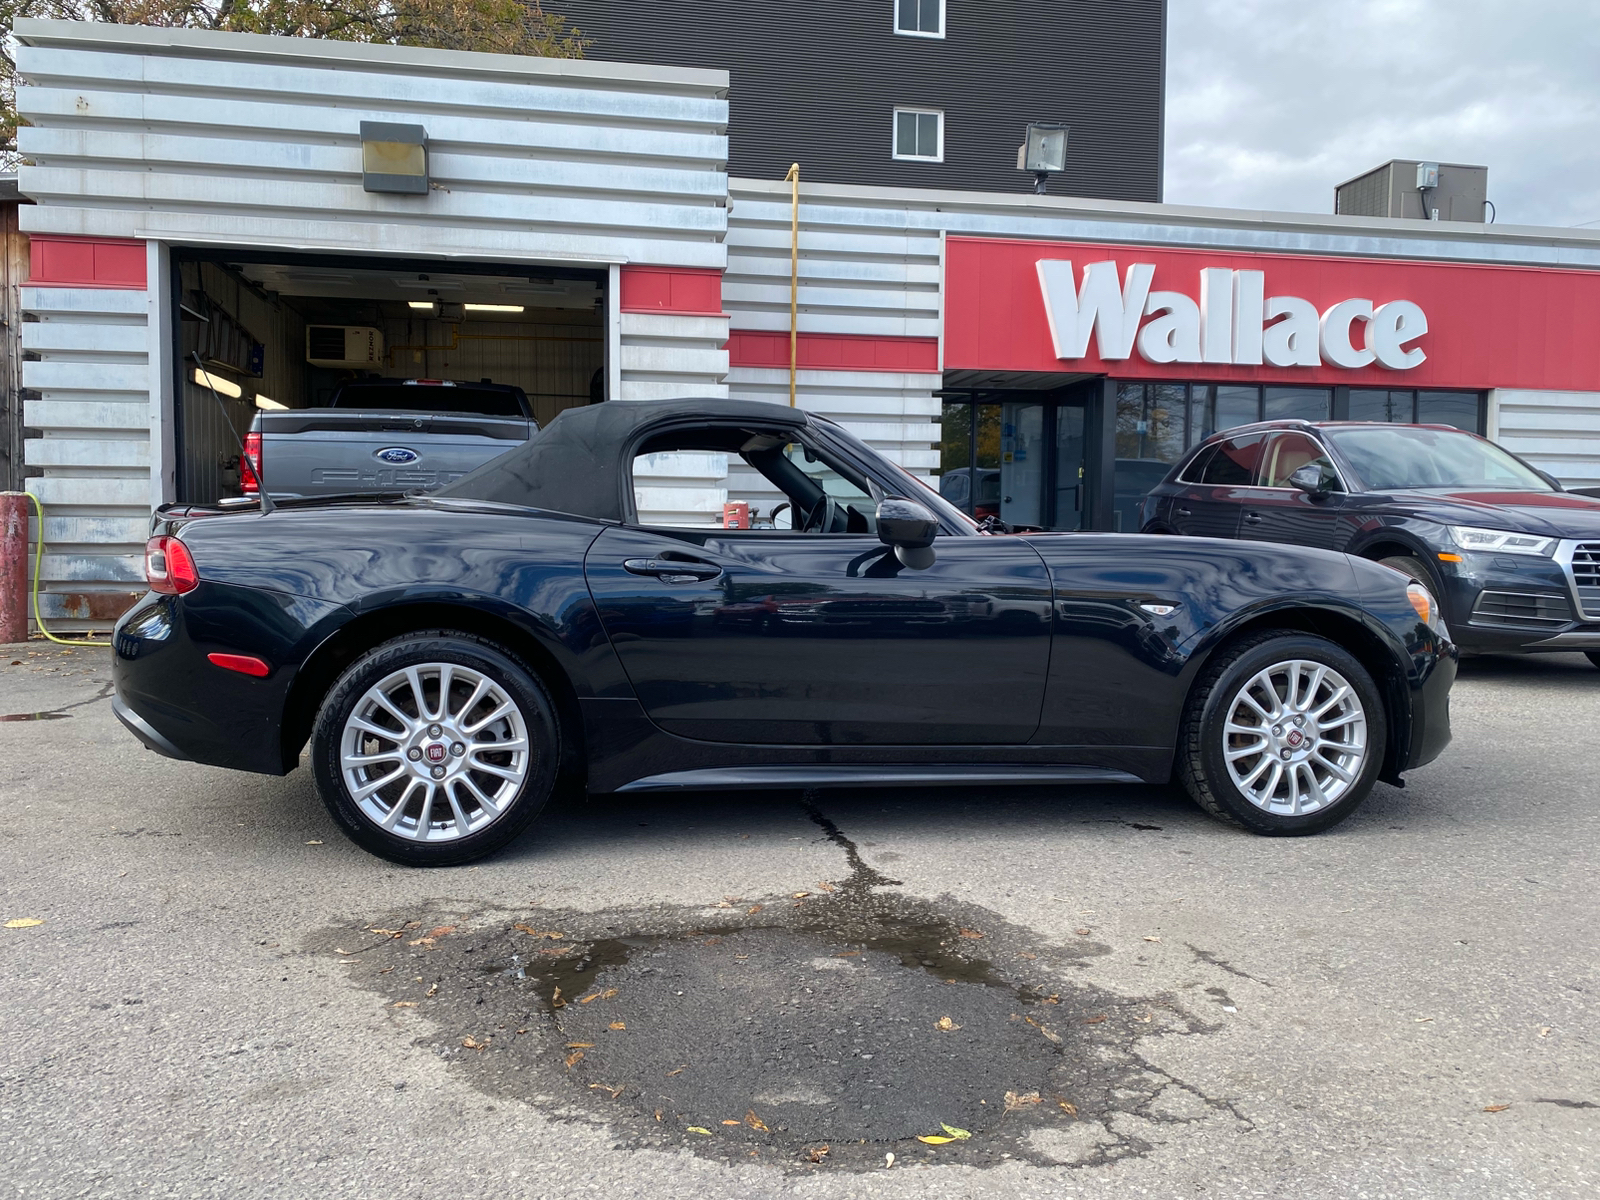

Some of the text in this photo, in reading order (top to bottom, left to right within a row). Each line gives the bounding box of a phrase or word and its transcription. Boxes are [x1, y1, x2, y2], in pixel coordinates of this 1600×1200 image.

[1036, 258, 1428, 370] Wallace
[388, 450, 408, 461] Ford
[317, 641, 456, 740] CONTINENTAL
[430, 747, 442, 758] FIAT
